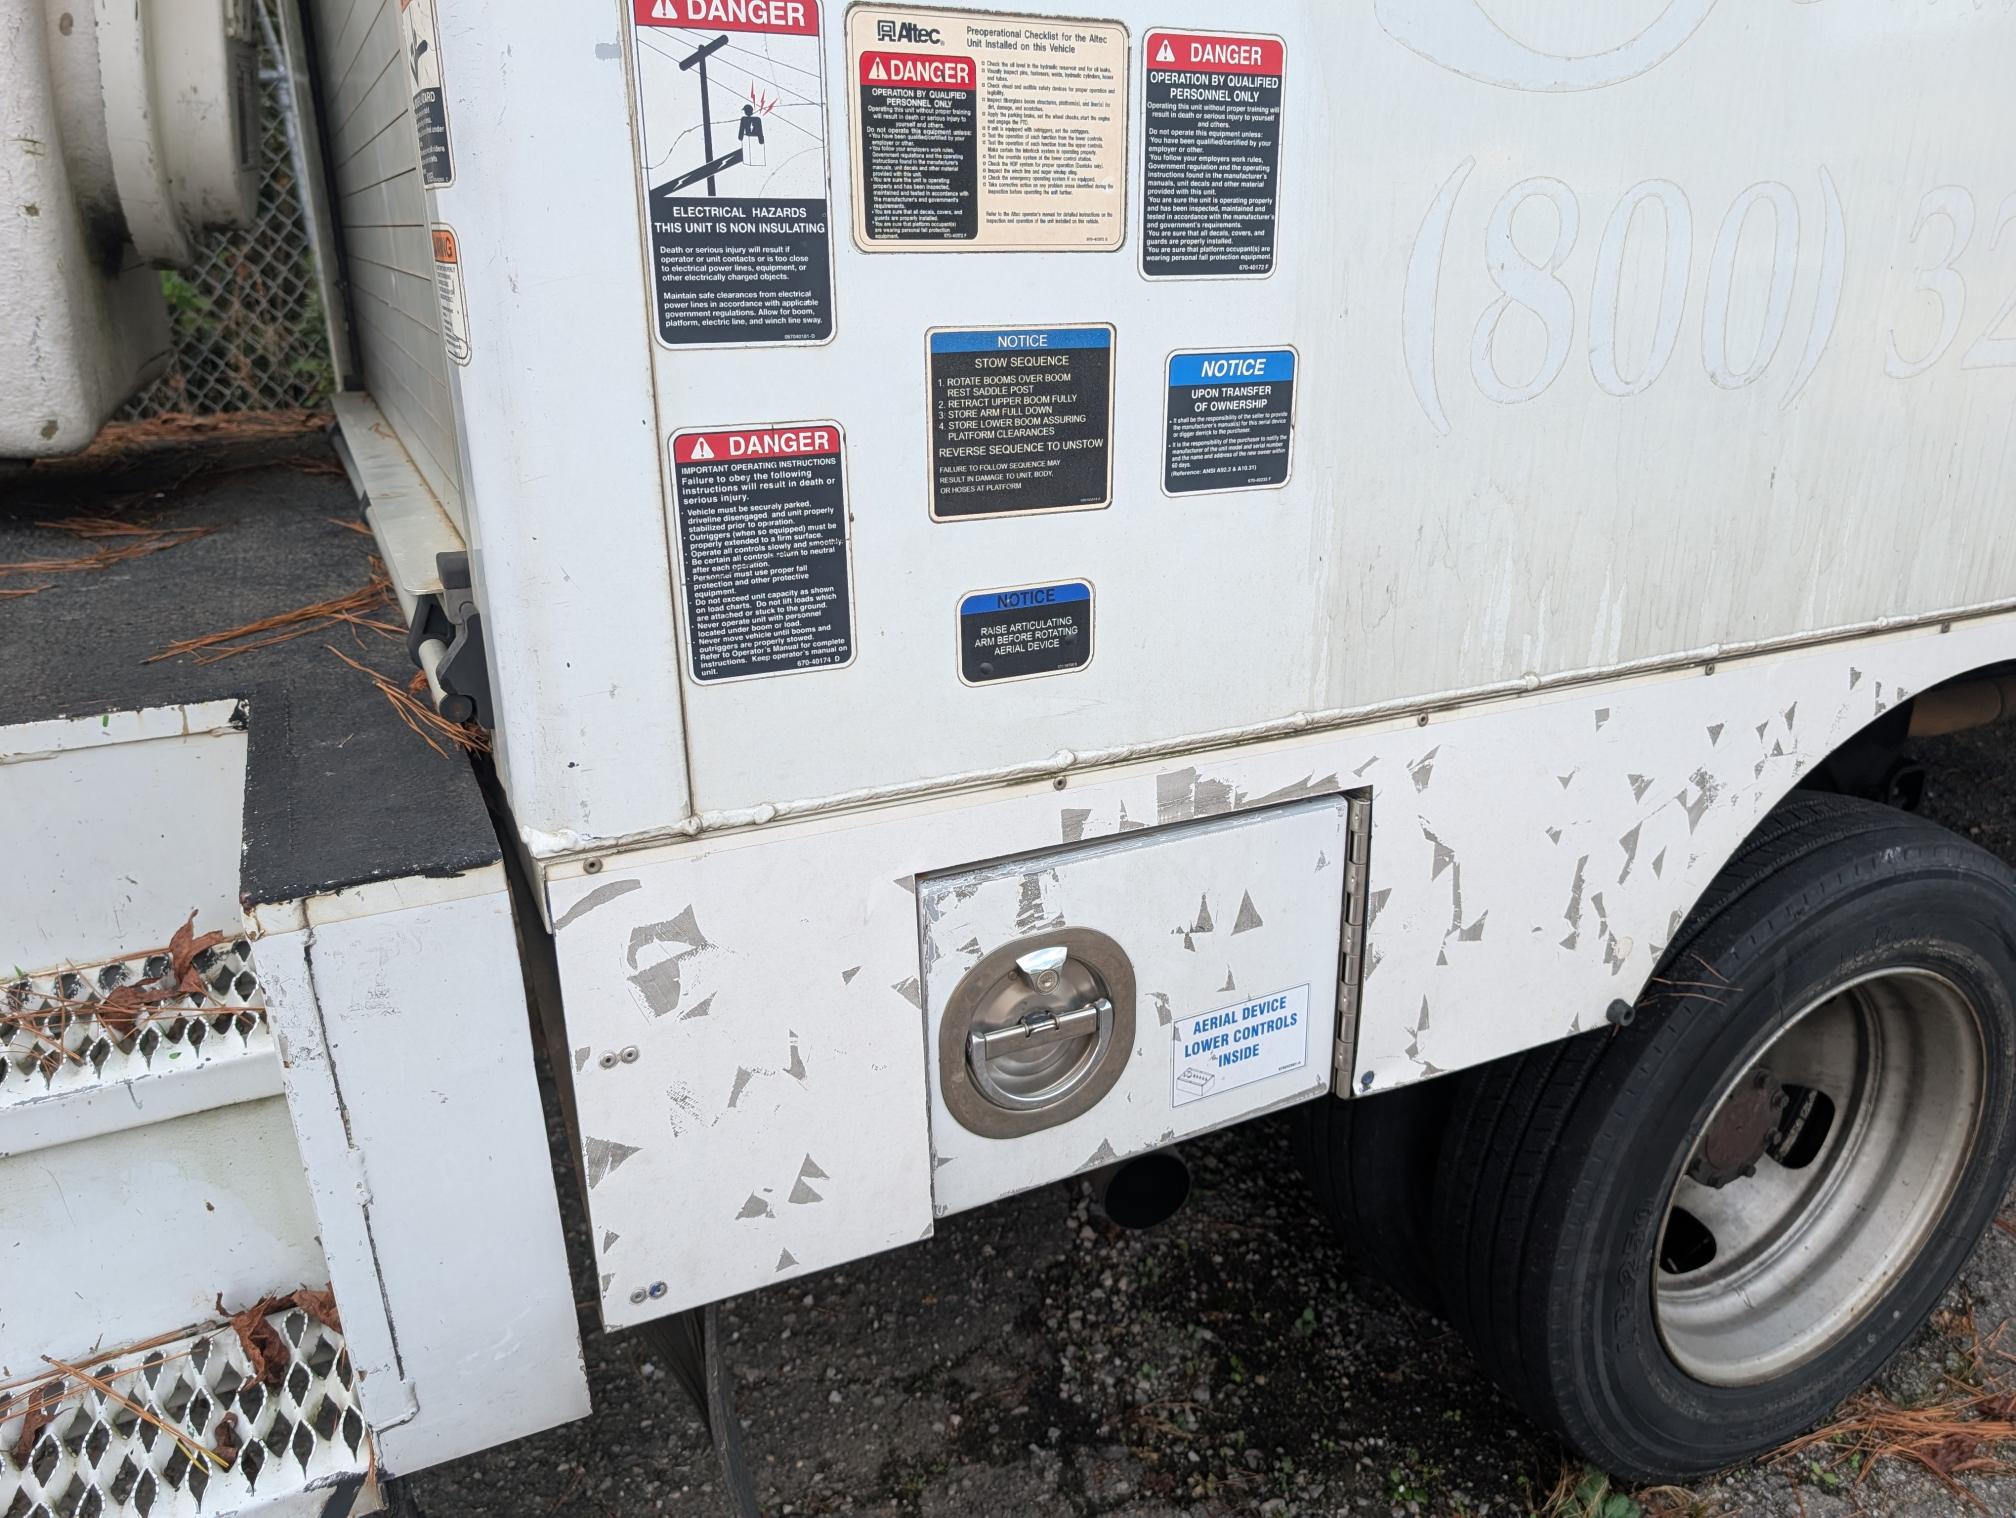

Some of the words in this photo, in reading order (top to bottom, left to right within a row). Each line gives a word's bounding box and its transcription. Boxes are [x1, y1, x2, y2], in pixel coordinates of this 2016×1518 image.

[686, 0, 806, 27] DANGER
[897, 21, 942, 46] Altec
[966, 25, 1021, 38] Preoperational
[1023, 29, 1058, 41] Checklist
[1061, 31, 1072, 41] for
[1074, 32, 1086, 42] the
[1088, 33, 1107, 44] Altec
[966, 38, 982, 48] Unit
[985, 39, 1017, 50] Installed
[1032, 42, 1046, 52] this
[1049, 42, 1075, 53] Vehicle
[1190, 42, 1261, 65] DANGER
[890, 59, 968, 83] DANGER
[1150, 71, 1208, 85] OPERATION
[1211, 74, 1225, 86] BY
[1227, 74, 1278, 88] QUALIFIED
[871, 87, 914, 99] OPERATION
[916, 89, 926, 97] BY
[928, 90, 966, 99] QUALIFIED
[1170, 88, 1231, 101] PERSONNEL
[1233, 90, 1259, 102] ONLY
[886, 97, 931, 108] PERSONNEL
[933, 99, 952, 108] ONLY
[672, 206, 746, 217] ELECTRICAL
[752, 207, 806, 218] HAZARDS
[654, 222, 682, 233] THIS
[684, 222, 712, 233] UNIT
[715, 222, 727, 233] IS
[729, 222, 755, 233] NON
[758, 222, 825, 233] INSULATING
[725, 245, 746, 254] injury
[747, 245, 760, 253] will
[762, 245, 783, 253] result
[660, 255, 694, 264] operator
[671, 264, 706, 272] electrical
[708, 265, 732, 273] power
[755, 264, 797, 272] equipment,
[662, 273, 682, 281] other
[684, 273, 726, 282] electrically
[727, 273, 758, 281] charged
[759, 273, 789, 281] objects.
[663, 291, 696, 299] Maintain
[698, 291, 715, 299] safe
[1401, 154, 1848, 437] (800)
[664, 302, 688, 310] power
[690, 300, 708, 308] lines
[781, 299, 818, 307] applicable
[664, 309, 711, 319] government
[712, 309, 756, 318] regulations.
[665, 319, 700, 328] platform,
[997, 334, 1047, 347] NOTICE
[974, 357, 1007, 368] STOW
[1010, 355, 1069, 367] SEQUENCE
[1201, 358, 1266, 377] NOTICE
[946, 376, 981, 386] ROTATE
[983, 375, 1016, 384] BOOMS
[1018, 373, 1043, 383] OVER
[1044, 372, 1071, 382] BOOM
[947, 387, 971, 397] REST
[972, 386, 1008, 396] SADDLE
[1010, 384, 1033, 394] POST
[1191, 388, 1219, 399] UPON
[1221, 385, 1271, 397] TRANSFER
[947, 397, 989, 408] RETRACT
[991, 396, 1021, 406] UPPER
[1023, 394, 1050, 404] BOOM
[1051, 393, 1077, 403] FULLY
[1194, 401, 1208, 412] OF
[1210, 399, 1267, 411] OWNERSHIP
[948, 408, 977, 418] STORE
[979, 407, 999, 417] ARM
[1001, 407, 1022, 416] FULL
[1025, 405, 1052, 415] DOWN
[948, 419, 978, 430] STORE
[980, 418, 1012, 428] LOWER
[1014, 416, 1041, 426] BOOM
[1042, 414, 1086, 424] ASSURING
[948, 430, 994, 440] PLATFORM
[996, 426, 1054, 438] CLEARANCES
[729, 431, 828, 455] DANGER
[939, 445, 986, 457] REVERSE
[988, 442, 1044, 454] SEQUENCE
[1046, 441, 1060, 451] TO
[1062, 438, 1103, 450] UNSTOW
[681, 464, 728, 474] IMPORTANT
[730, 461, 777, 471] OPERATING
[778, 457, 836, 468] INSTRUCTIONS
[681, 476, 714, 485] Failure
[716, 475, 726, 483] to
[728, 474, 750, 482] obey
[753, 472, 768, 480] the
[770, 470, 811, 480] following
[682, 484, 738, 495] instructions
[740, 482, 756, 490] will
[759, 480, 785, 489] result
[799, 478, 823, 486] death
[683, 495, 718, 505] serious
[720, 494, 749, 503] injury.
[997, 588, 1055, 608] NOTICE
[980, 624, 1007, 636] RAISE
[1009, 616, 1072, 632] ARTICULATING
[974, 637, 994, 647] ARM
[996, 631, 1032, 644] BEFORE
[1034, 626, 1078, 639] ROTATING
[994, 643, 1025, 655] AERIAL
[1027, 638, 1059, 651] DEVICE
[1193, 1010, 1237, 1035] AERIAL
[1242, 996, 1286, 1020] DEVICE
[1184, 1033, 1228, 1057] LOWER
[1233, 1012, 1297, 1042] CONTROLS
[1218, 1043, 1259, 1067] INSIDE
